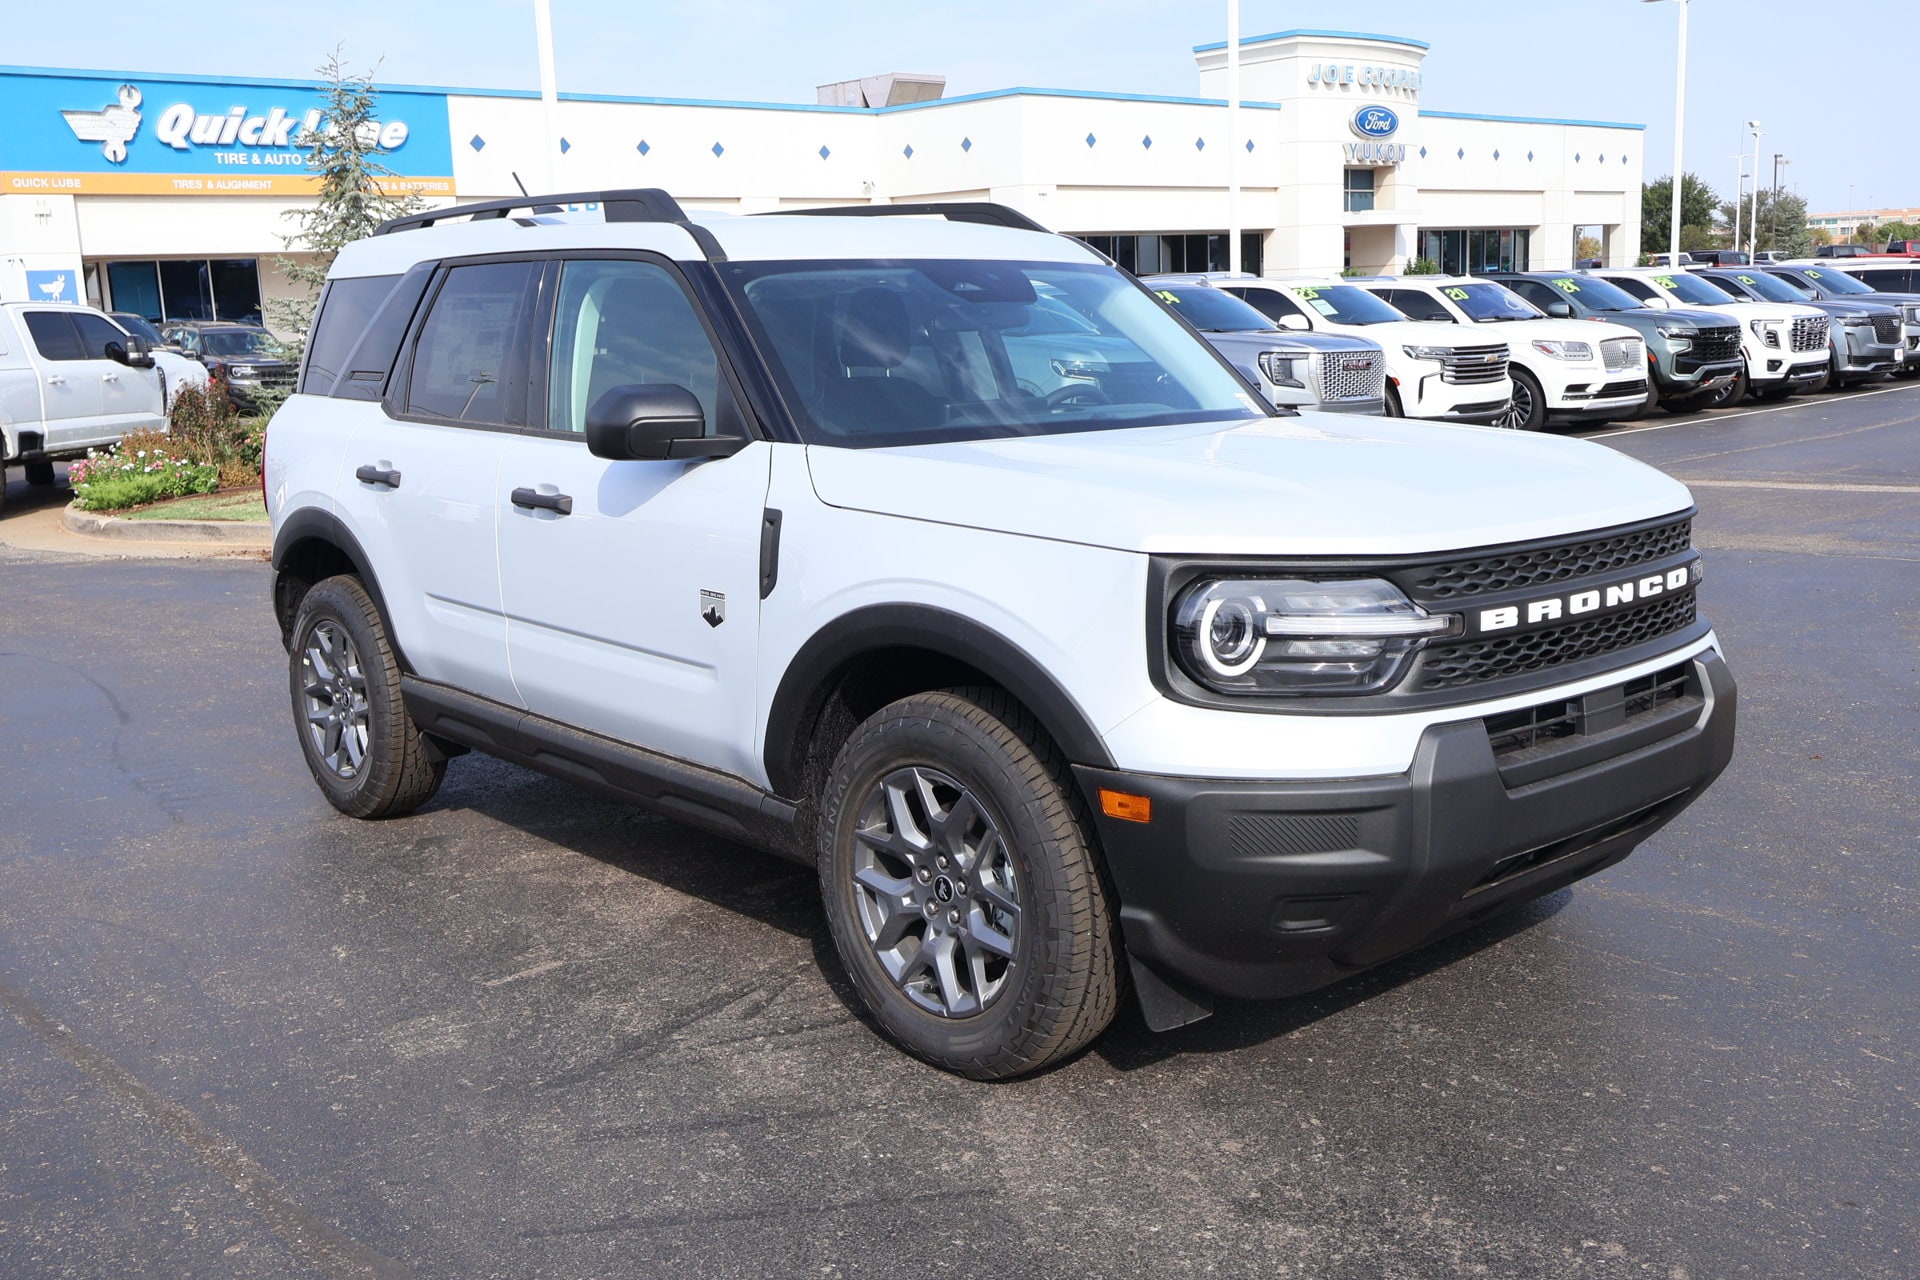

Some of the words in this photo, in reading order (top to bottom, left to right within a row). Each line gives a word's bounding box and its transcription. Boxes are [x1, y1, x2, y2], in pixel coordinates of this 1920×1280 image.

[1309, 63, 1354, 83] JOE
[156, 102, 297, 148] Quick
[1365, 111, 1391, 130] Ford
[214, 152, 248, 164] TIRE
[251, 153, 261, 164] &
[264, 153, 302, 165] AUTO
[1346, 143, 1405, 161] YUKON
[12, 178, 49, 188] QUICK
[51, 178, 82, 188] LUBE
[172, 179, 202, 189] TIRES
[207, 180, 214, 189] &
[216, 180, 272, 190] ALIGNMENT
[391, 182, 398, 190] &
[400, 182, 449, 191] BATTERIES
[1444, 287, 1470, 301] 20
[1480, 567, 1688, 632] BRONCO
